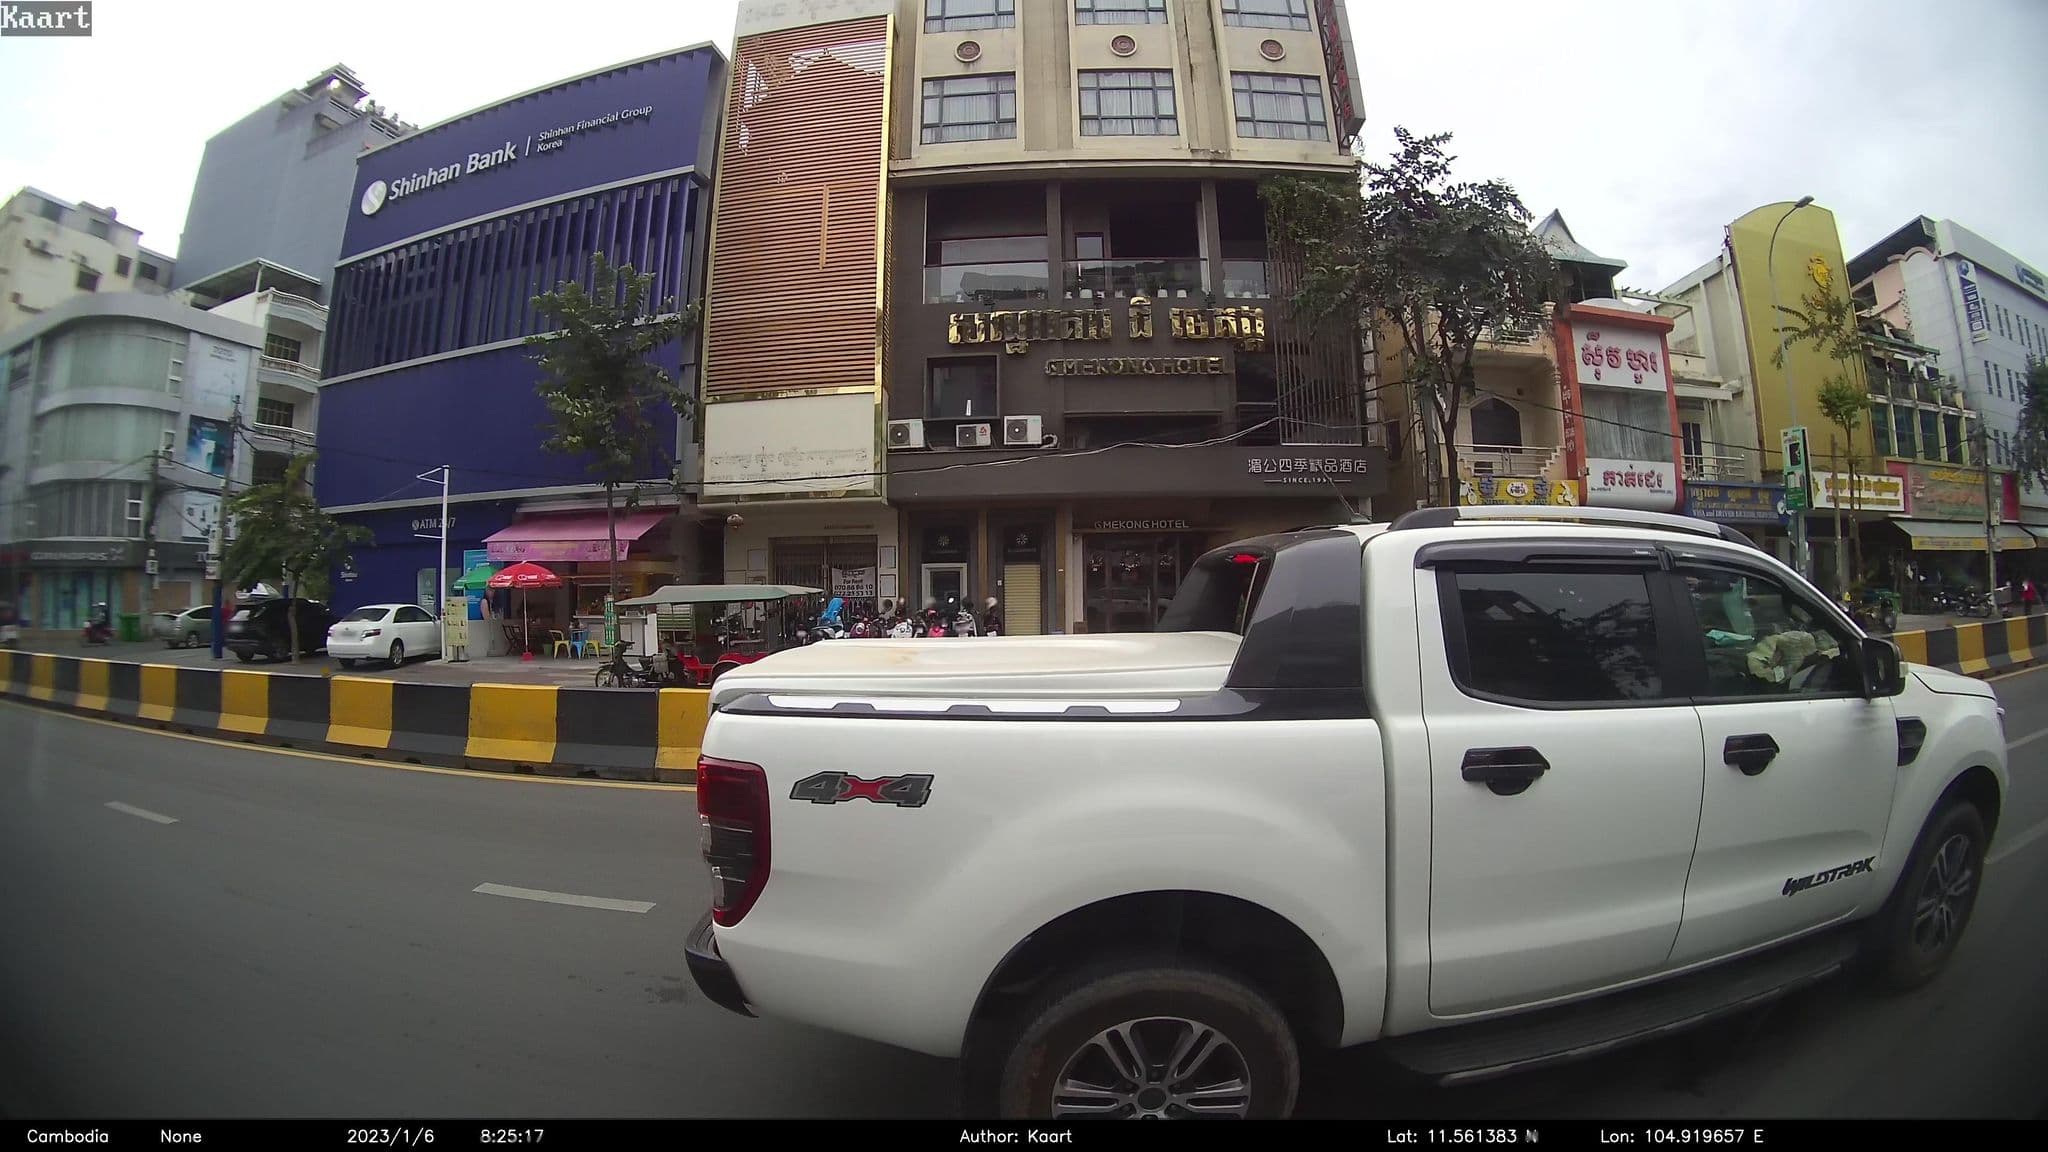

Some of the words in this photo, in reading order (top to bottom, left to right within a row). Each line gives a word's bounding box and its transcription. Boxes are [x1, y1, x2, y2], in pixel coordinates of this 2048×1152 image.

[538, 124, 575, 142] Shinhan
[576, 112, 620, 131] Financial
[620, 105, 653, 121] Group
[537, 138, 563, 152] Korea
[388, 162, 461, 200] Shinhan
[466, 141, 517, 175] Bank
[420, 518, 437, 529] ATM
[438, 517, 456, 529] 2/7
[1151, 519, 1190, 529] HOTEL
[1782, 856, 1876, 897] WILDTRAK
